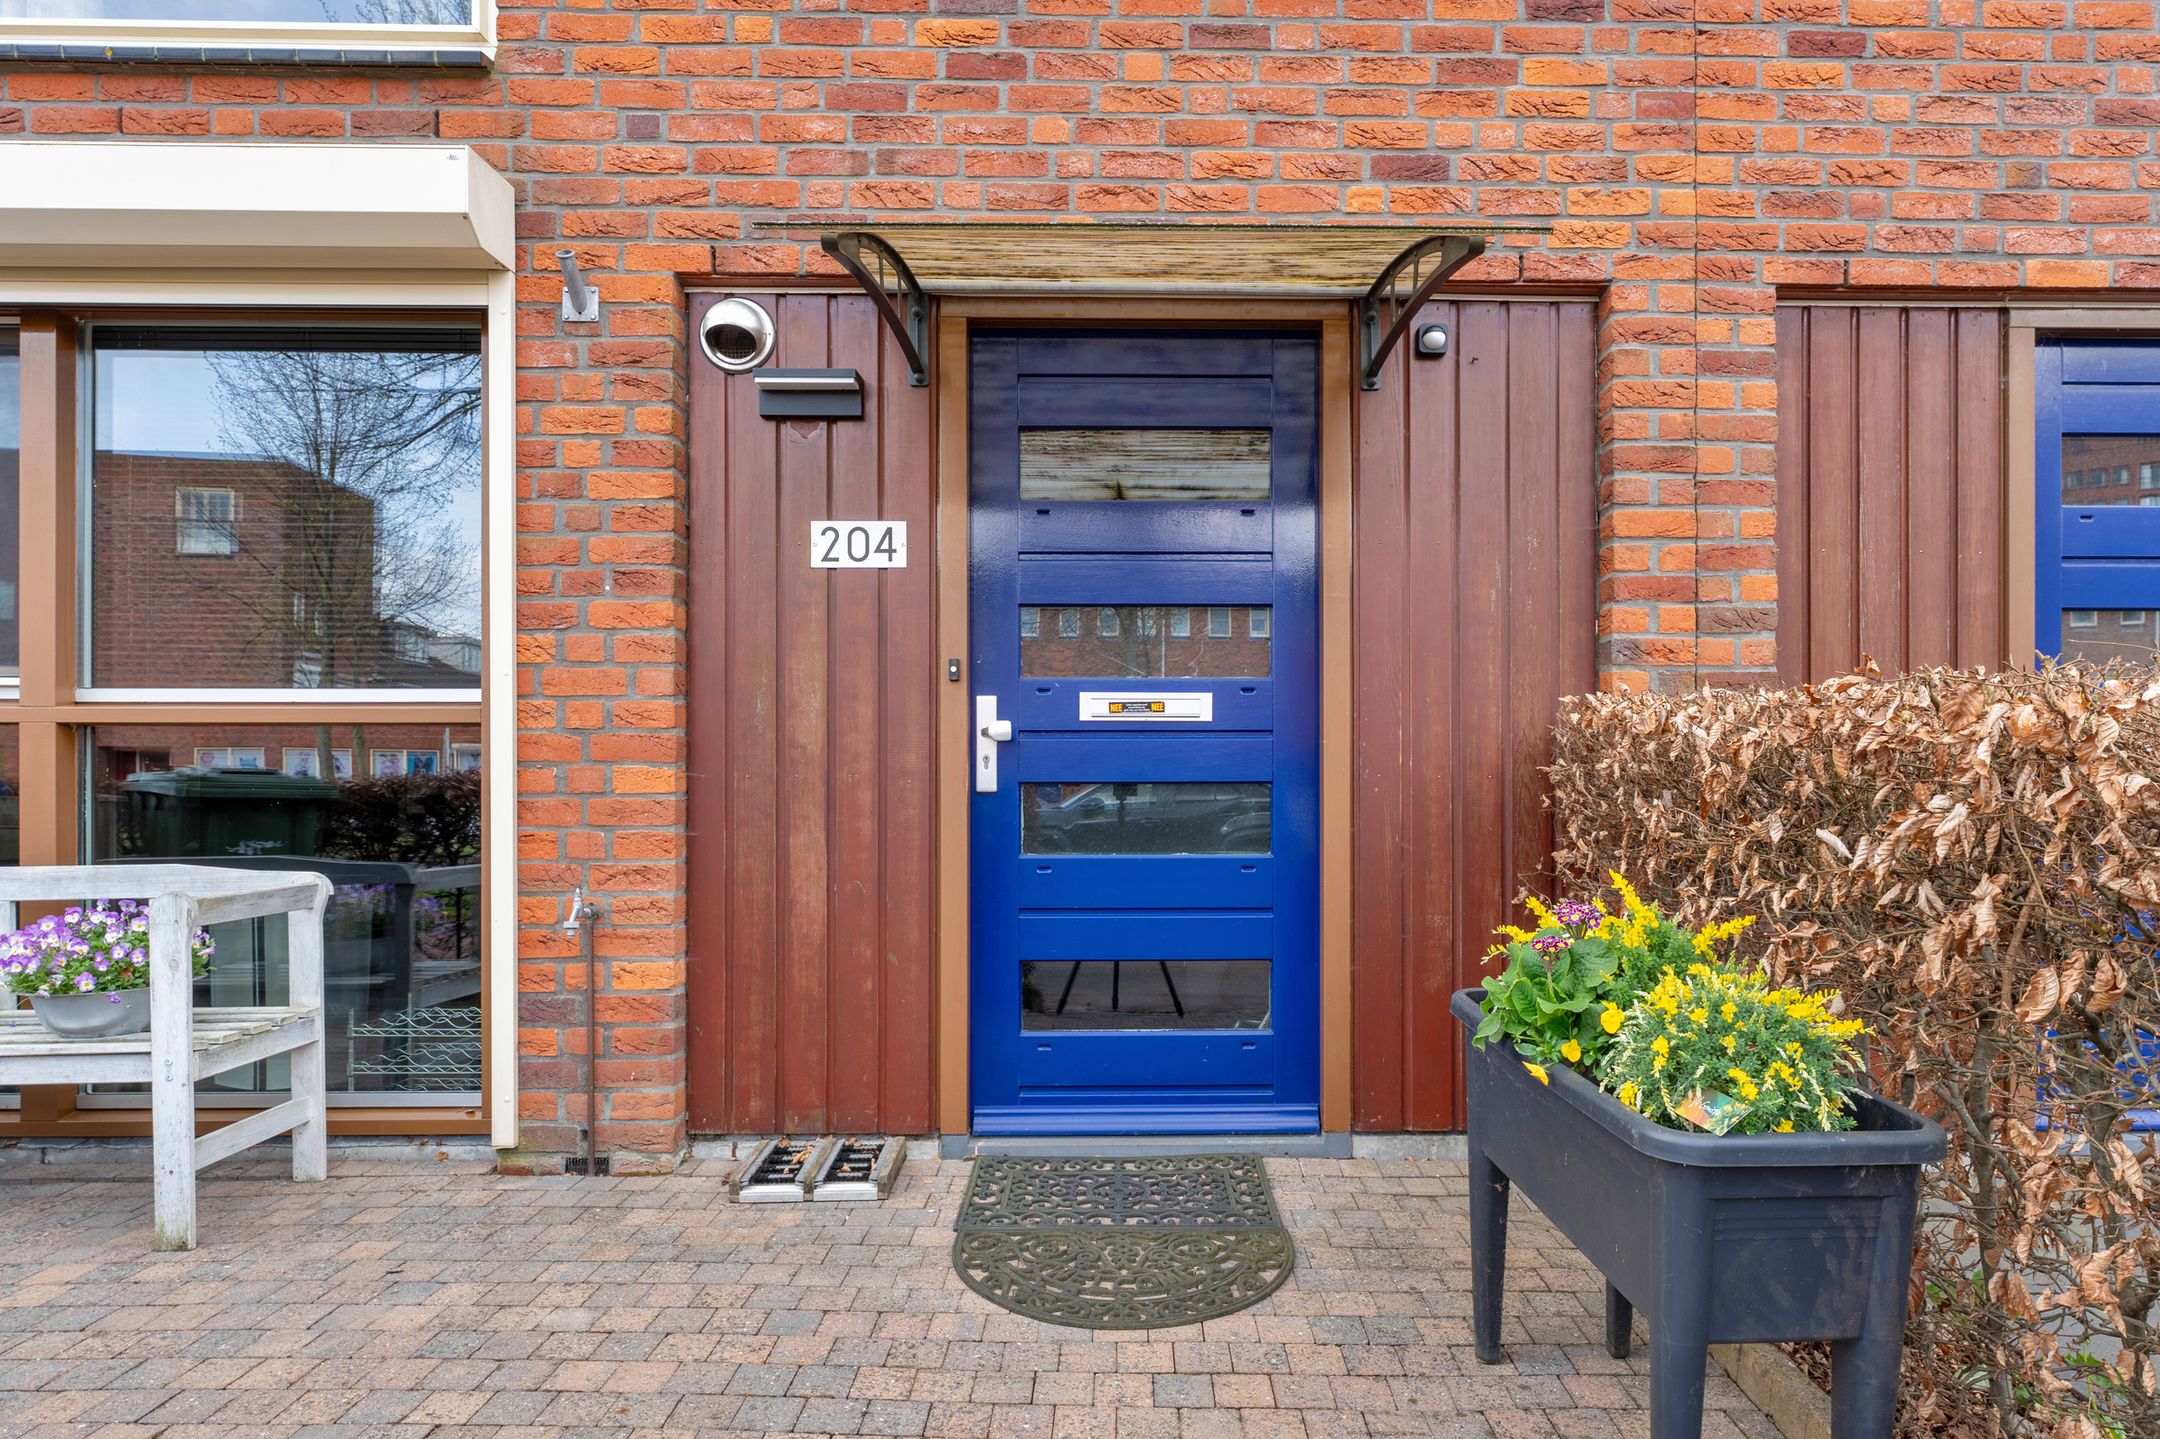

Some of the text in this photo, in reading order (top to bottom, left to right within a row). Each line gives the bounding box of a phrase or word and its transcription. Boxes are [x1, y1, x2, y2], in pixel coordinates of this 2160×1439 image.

[820, 526, 897, 562] 204
[1110, 703, 1123, 713] NEE
[1151, 702, 1164, 711] NEE
